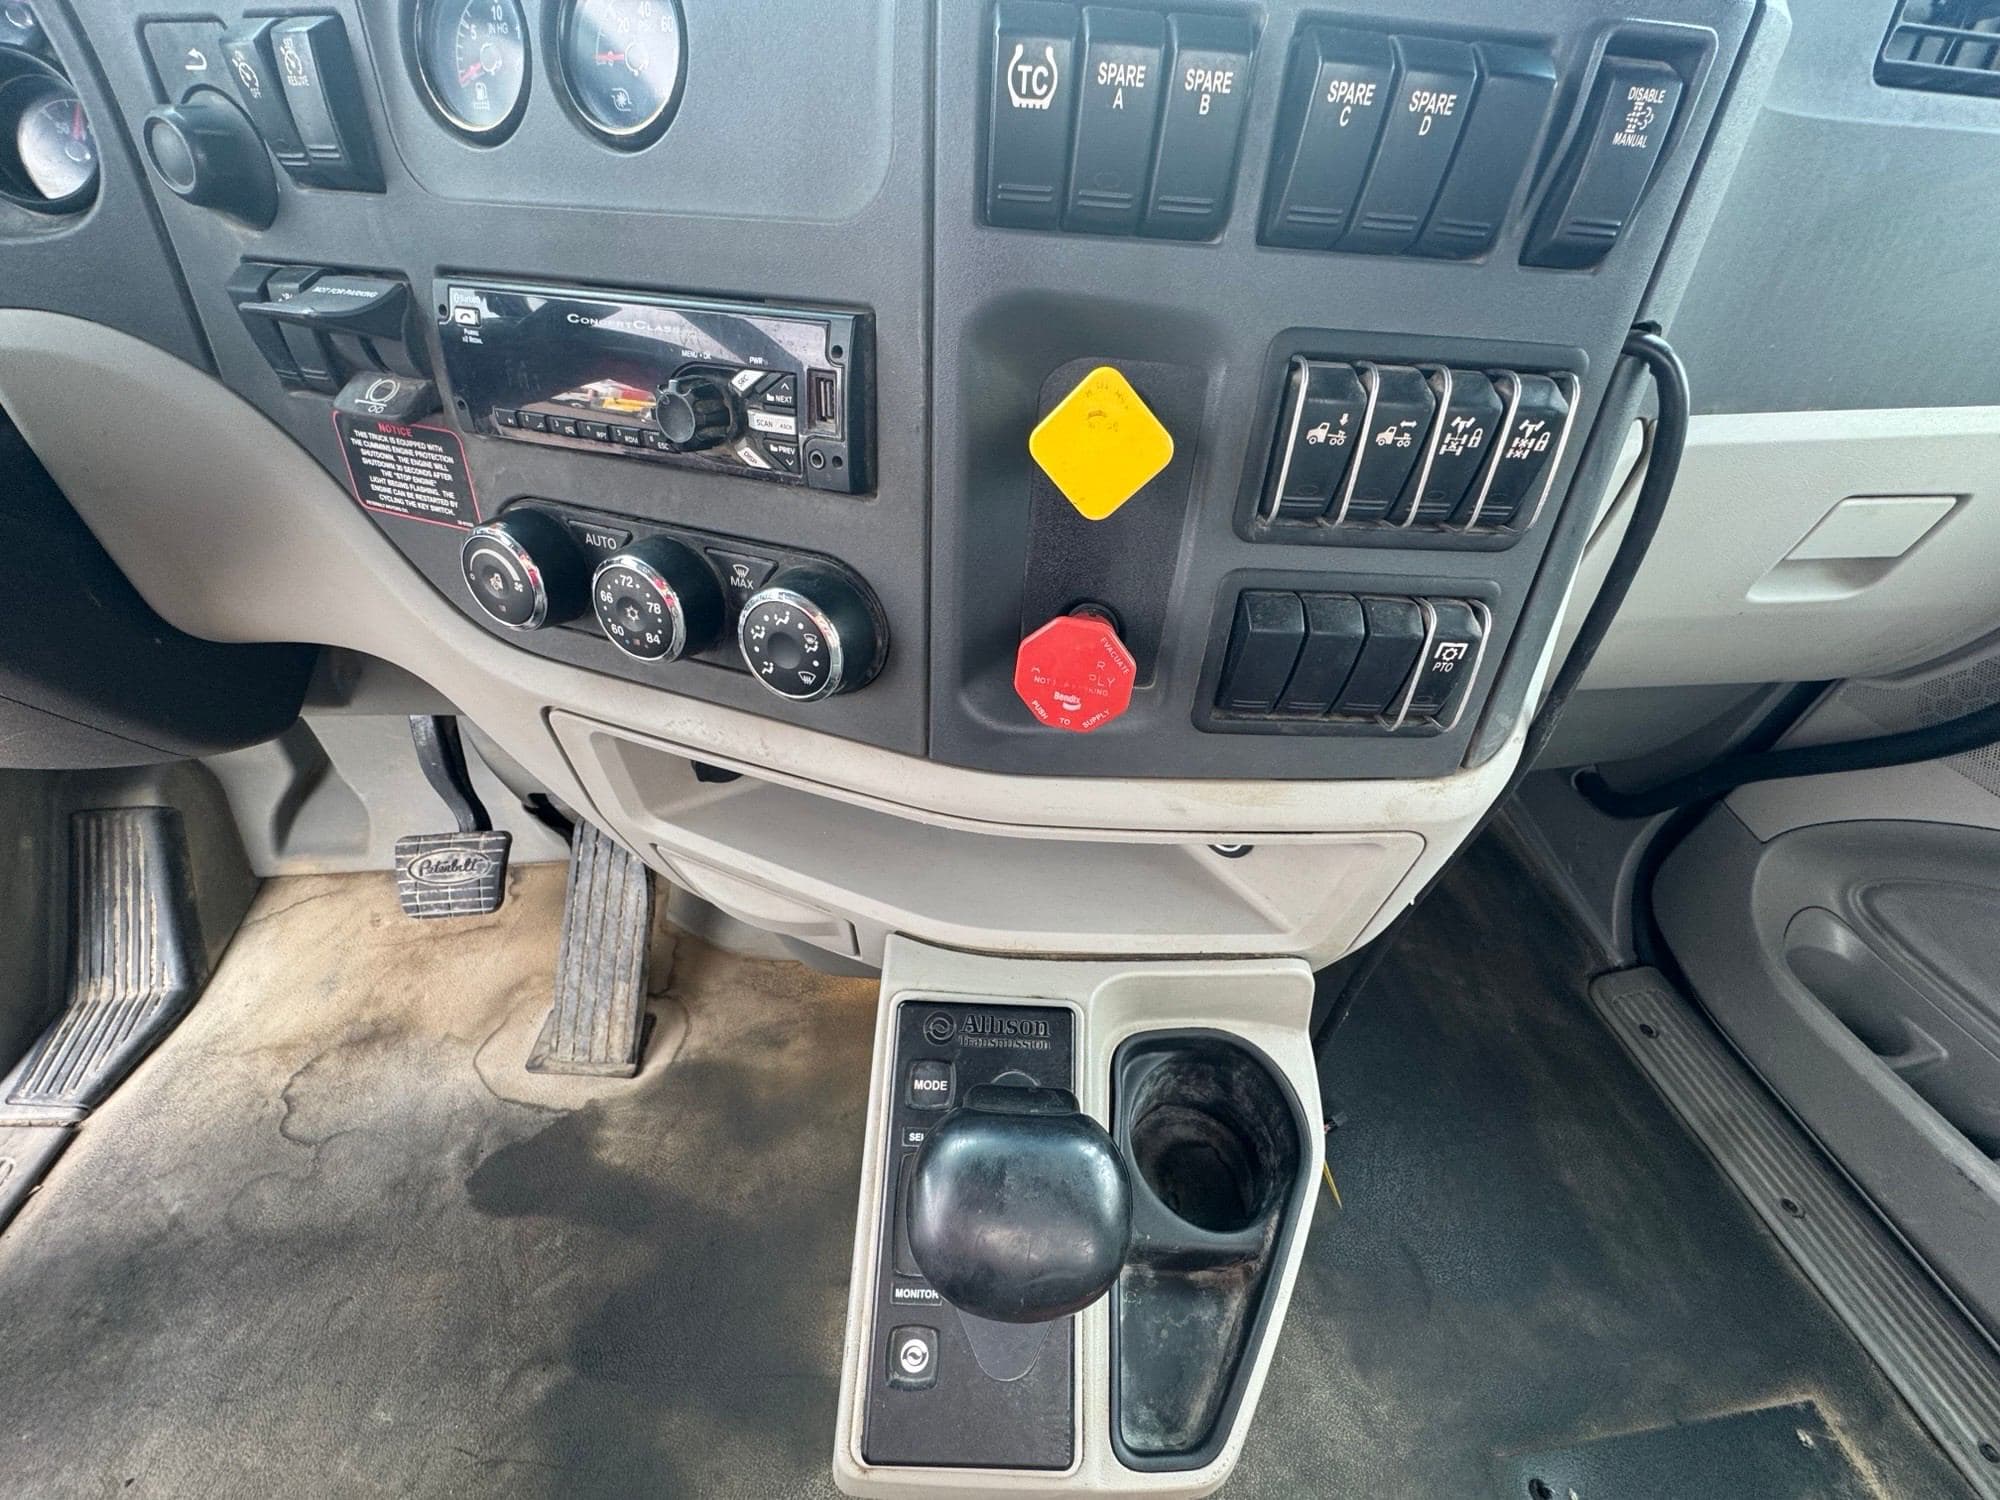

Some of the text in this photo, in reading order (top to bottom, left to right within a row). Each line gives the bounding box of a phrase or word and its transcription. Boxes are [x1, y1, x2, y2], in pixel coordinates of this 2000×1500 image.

[491, 4, 503, 21] 10
[470, 24, 477, 40] 5
[617, 17, 630, 33] 20
[661, 16, 674, 32] 60
[1017, 65, 1049, 96] TC
[1097, 62, 1146, 88] SPARE
[1184, 68, 1234, 94] SPARE
[1112, 88, 1124, 110] A
[1327, 79, 1376, 106] SPARE
[1627, 85, 1667, 104] DISABLE
[1198, 94, 1211, 115] B
[1408, 90, 1457, 116] SPARE
[1339, 105, 1352, 127] C
[1418, 115, 1433, 136] D
[1612, 132, 1649, 149] MANUAL
[681, 349, 698, 358] MENU
[749, 356, 763, 365] PWR
[775, 394, 792, 404] NEXT
[378, 423, 413, 437] NOTICE
[756, 418, 773, 428] SCAN
[350, 437, 363, 447] THE
[391, 445, 414, 457] ENGINE
[414, 449, 455, 464] PROTECTION
[368, 432, 389, 443] TRUCK
[395, 438, 427, 450] EQUIPPED
[426, 443, 444, 453] WITH
[658, 442, 670, 450] ESC
[778, 445, 796, 456] PREV
[361, 457, 396, 470] SHUTDOWN
[403, 464, 433, 477] SECONDS
[433, 471, 453, 482] AFTER
[397, 455, 410, 464] THE
[410, 457, 433, 469] ENGINE
[433, 462, 449, 472] WILL
[380, 469, 393, 479] THE
[369, 475, 387, 485] LIGHT
[442, 490, 456, 499] THE
[370, 483, 393, 494] ENGINE
[392, 488, 406, 498] CAN
[415, 492, 450, 507] RESTARTED
[378, 493, 405, 505] CYCLING
[404, 498, 418, 508] THE
[417, 502, 430, 511] KEY
[585, 532, 618, 550] AUTO
[620, 575, 633, 588] 72
[731, 576, 755, 591] MAX
[600, 590, 614, 604] 66
[646, 600, 661, 615] 78
[611, 623, 625, 637] 60
[646, 632, 661, 645] 84
[1100, 637, 1130, 675] EVACUATE
[1432, 661, 1454, 673] PTO
[1054, 691, 1081, 705] Bendix
[1032, 699, 1111, 728] PUSH TO SUPPLY
[419, 858, 480, 877] Peterbilt
[959, 1014, 1052, 1037] Allison
[959, 1035, 1052, 1050] Transmission
[913, 1080, 948, 1092] MODE
